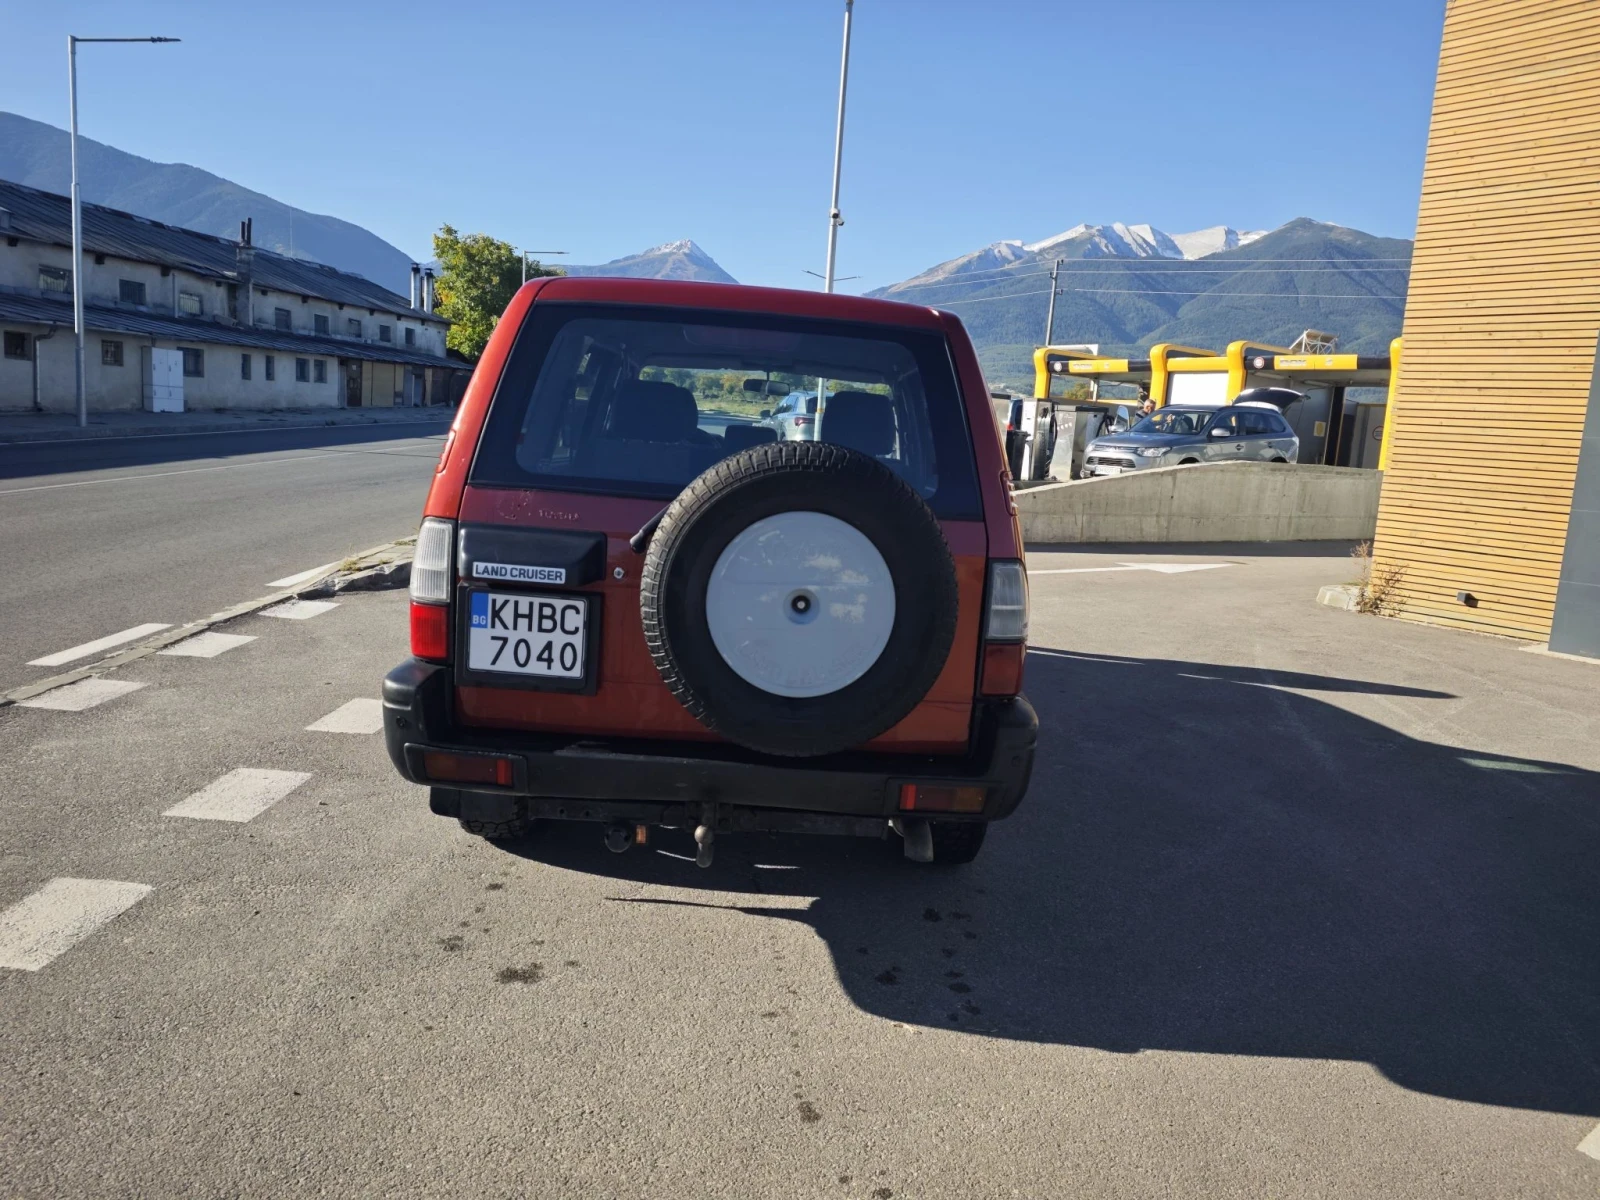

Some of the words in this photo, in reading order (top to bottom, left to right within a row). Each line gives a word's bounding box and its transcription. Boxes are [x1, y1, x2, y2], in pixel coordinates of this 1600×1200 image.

[475, 564, 507, 577] LAND
[510, 567, 563, 581] CRUISER
[473, 615, 486, 624] BG
[491, 598, 580, 635] KHBC
[490, 636, 578, 672] 7040
